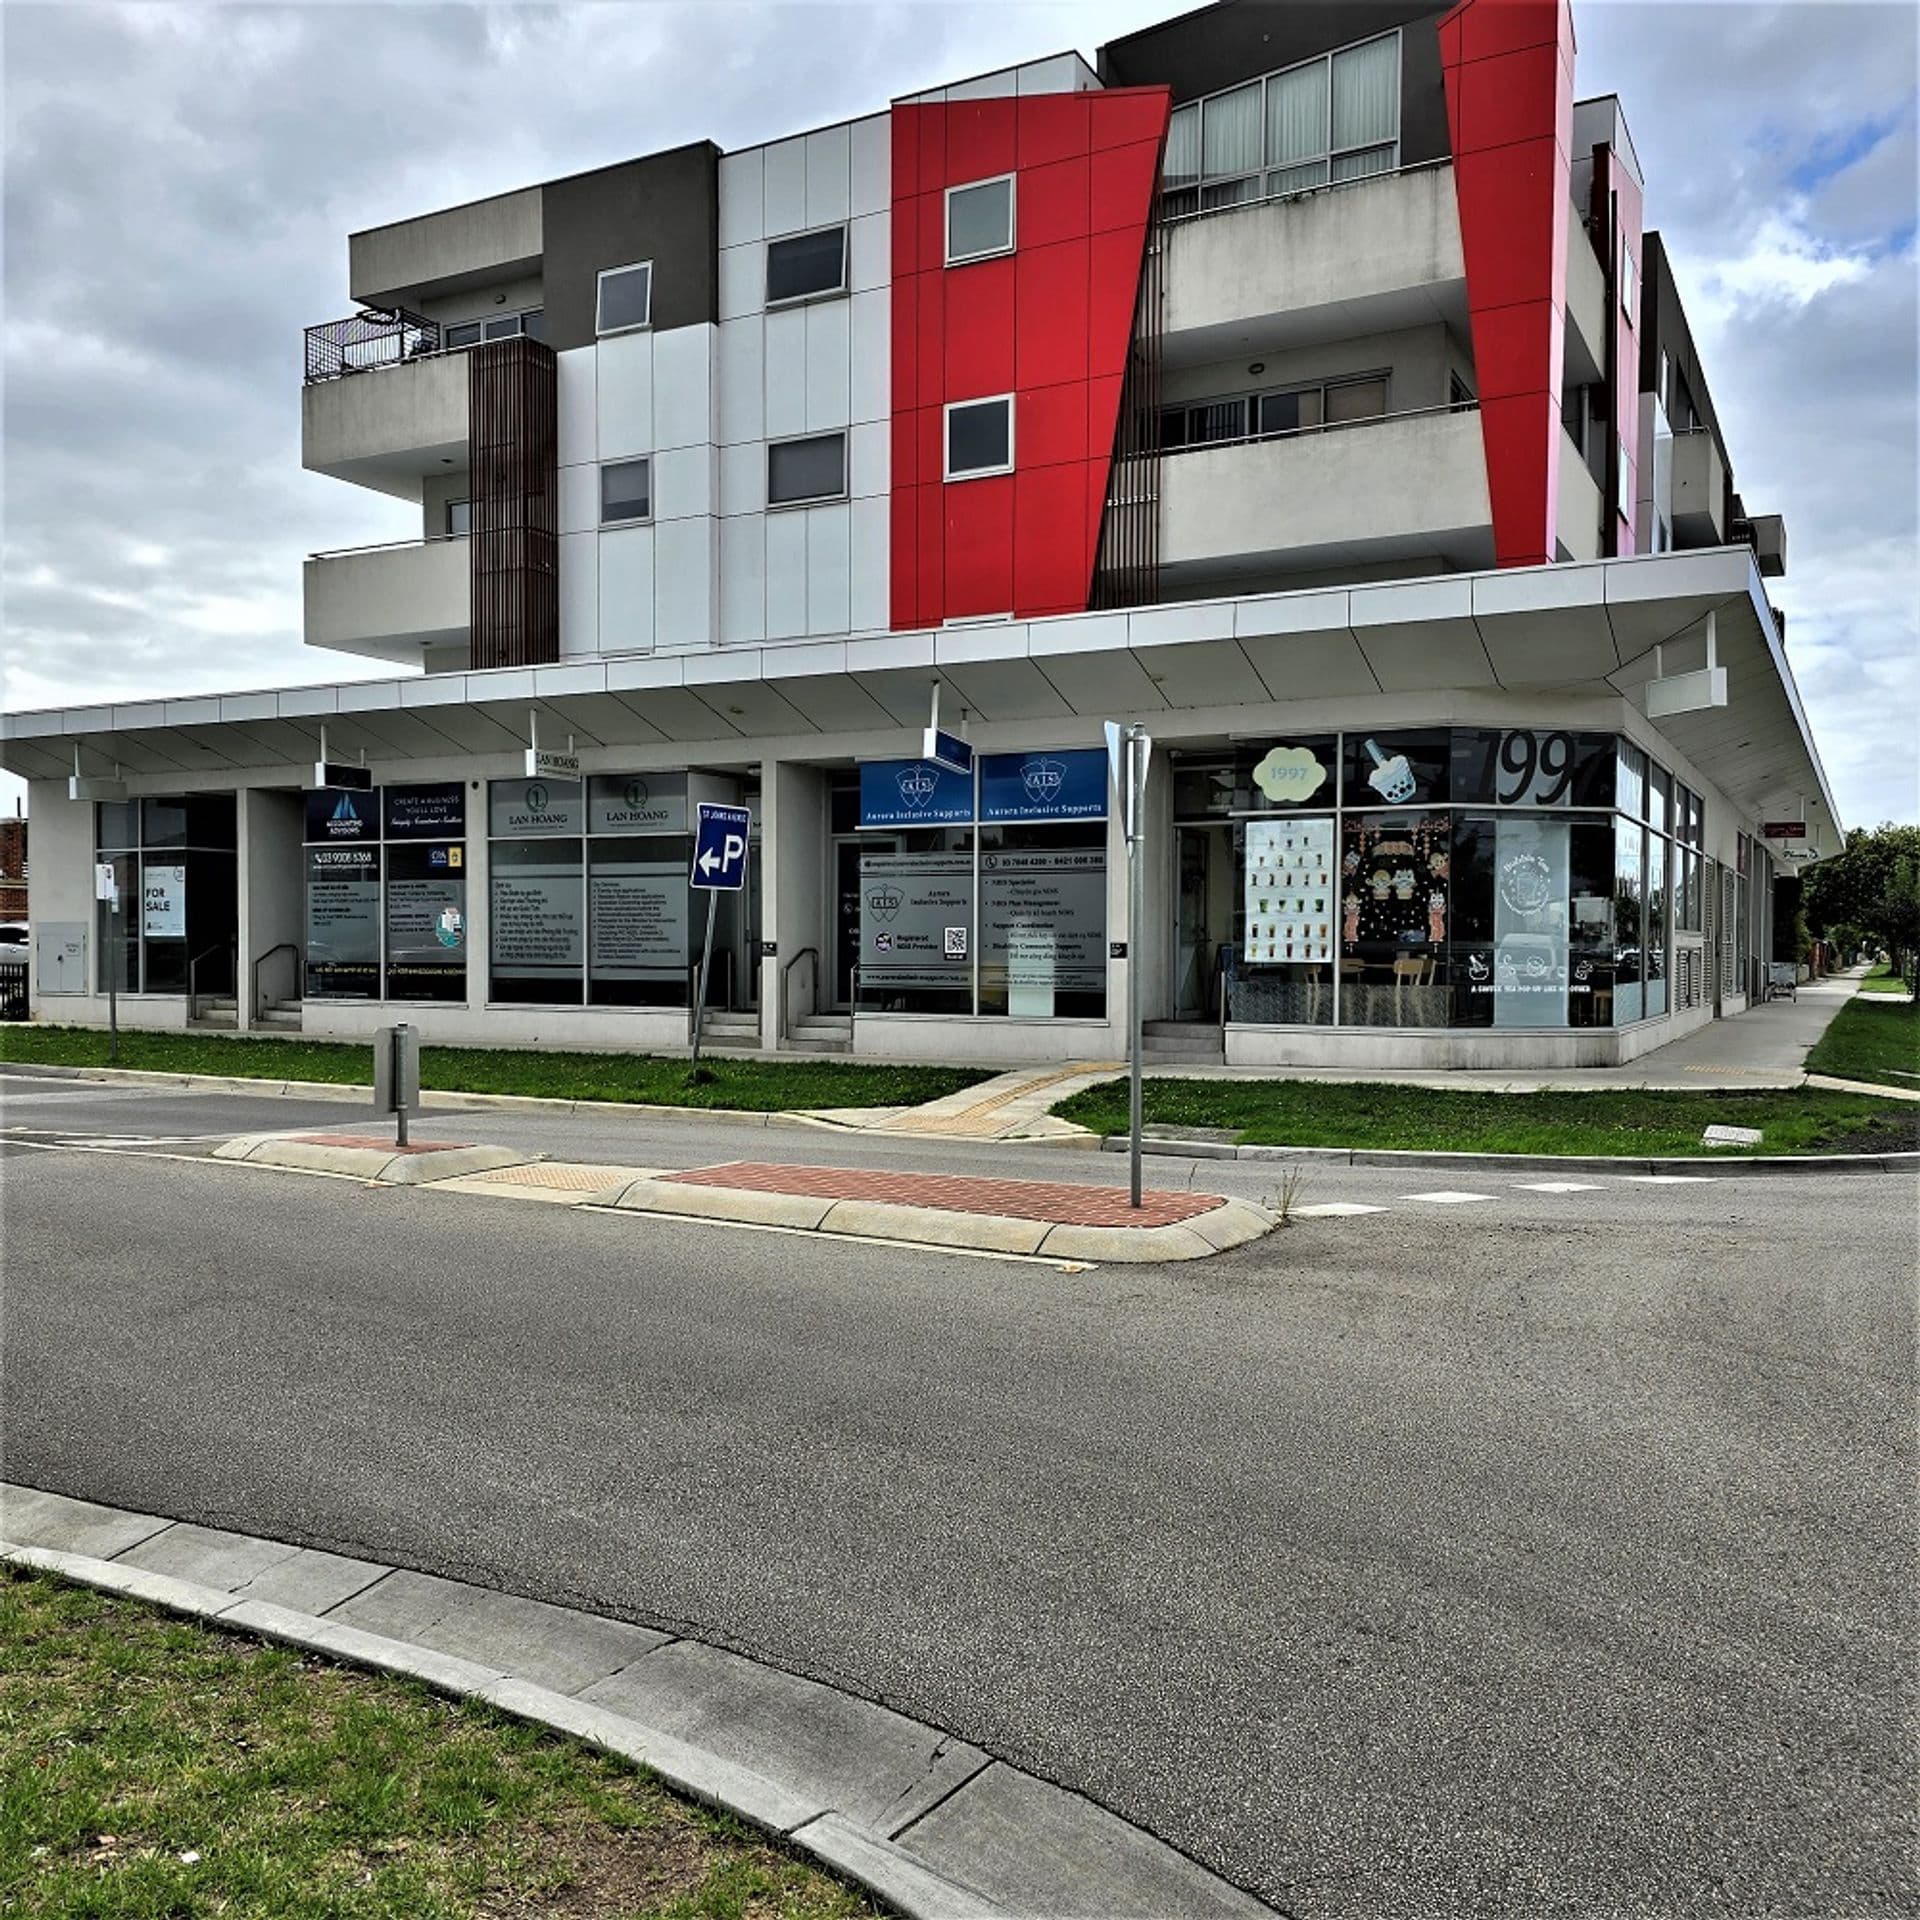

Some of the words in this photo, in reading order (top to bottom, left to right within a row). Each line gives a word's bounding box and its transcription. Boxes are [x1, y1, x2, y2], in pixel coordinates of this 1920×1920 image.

[1271, 767, 1307, 780] 1997
[509, 815, 530, 825] LAN
[531, 813, 568, 823] HOANG
[606, 811, 627, 821] LAN
[629, 810, 669, 820] HOANG
[722, 835, 744, 873] P
[146, 888, 165, 898] FOR
[146, 901, 170, 911] SALE
